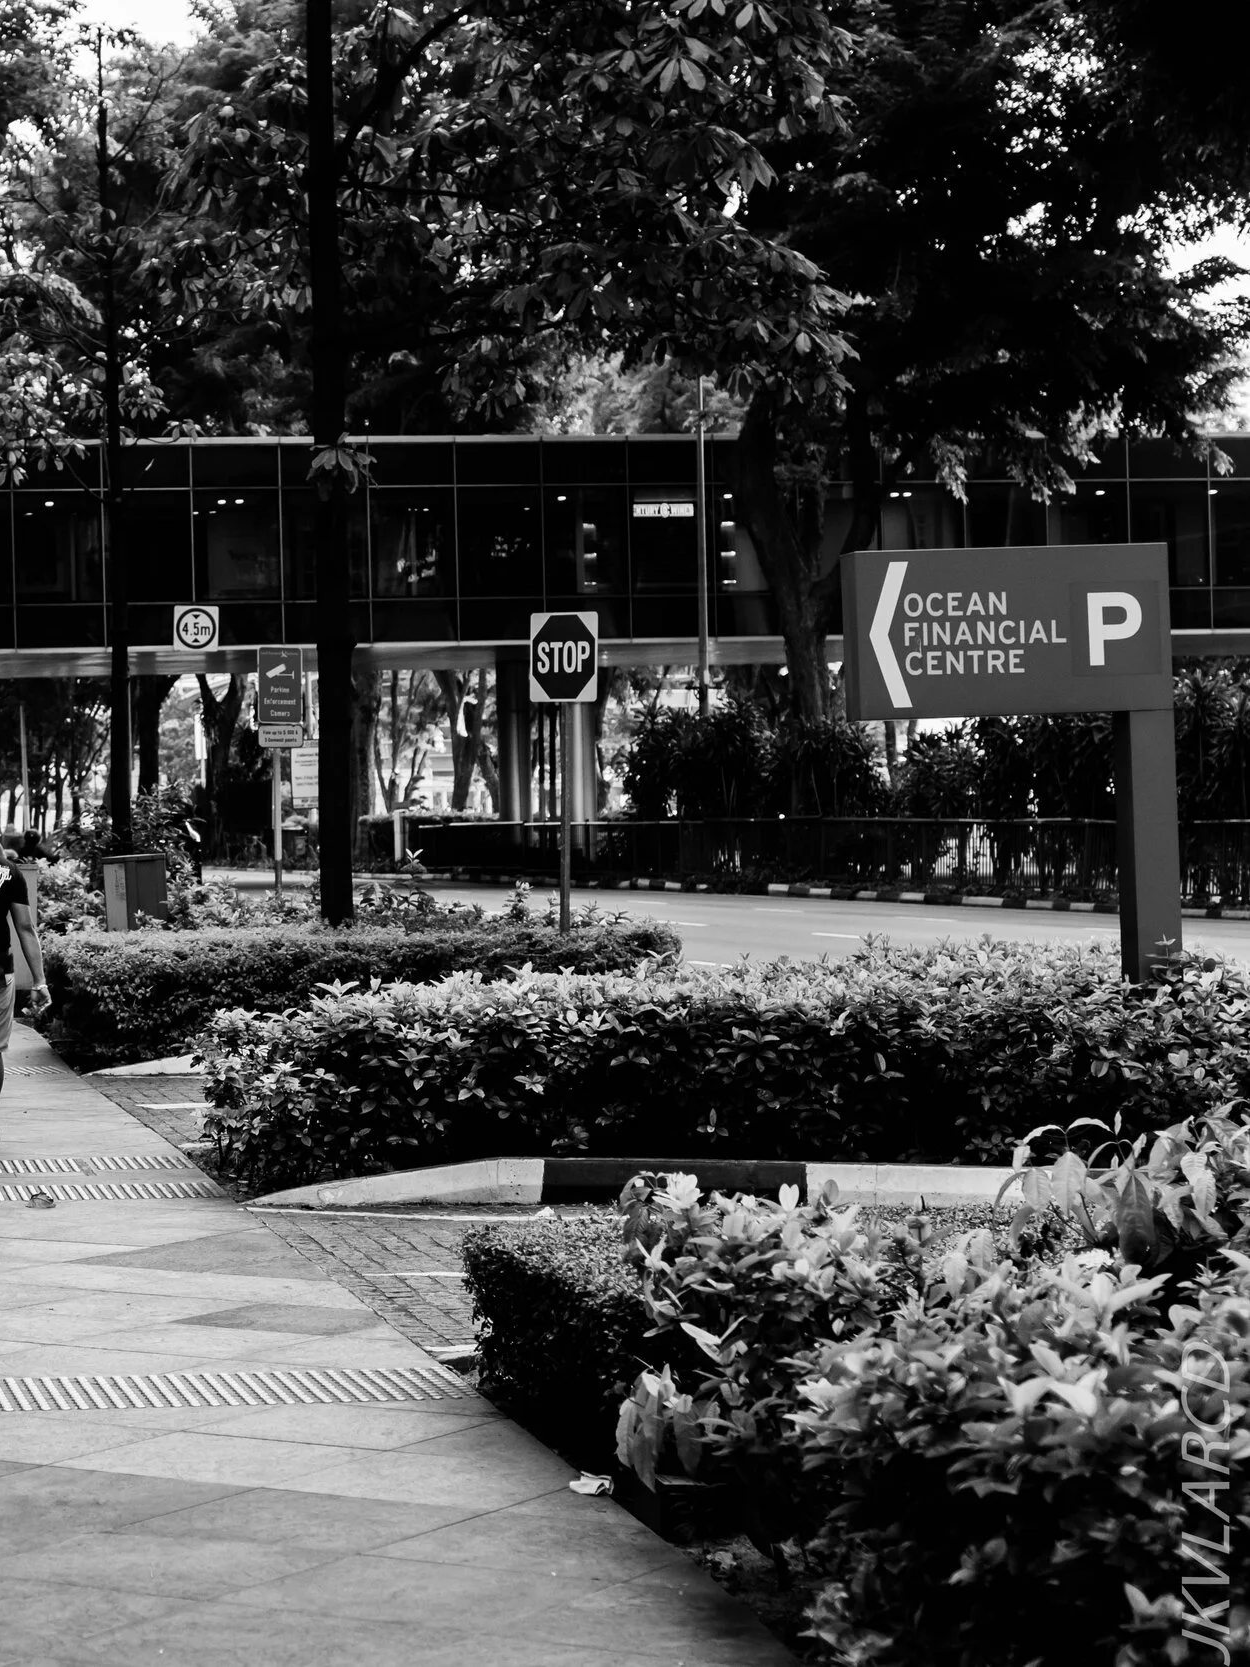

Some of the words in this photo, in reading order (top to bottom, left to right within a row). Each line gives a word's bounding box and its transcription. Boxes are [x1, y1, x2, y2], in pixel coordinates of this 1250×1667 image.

[903, 591, 1008, 618] OCEAN
[182, 622, 211, 636] 4.5m
[903, 619, 1068, 647] FINANCIAL
[1086, 591, 1143, 667] P
[537, 641, 591, 674] STOP
[905, 649, 1026, 676] CENTRE
